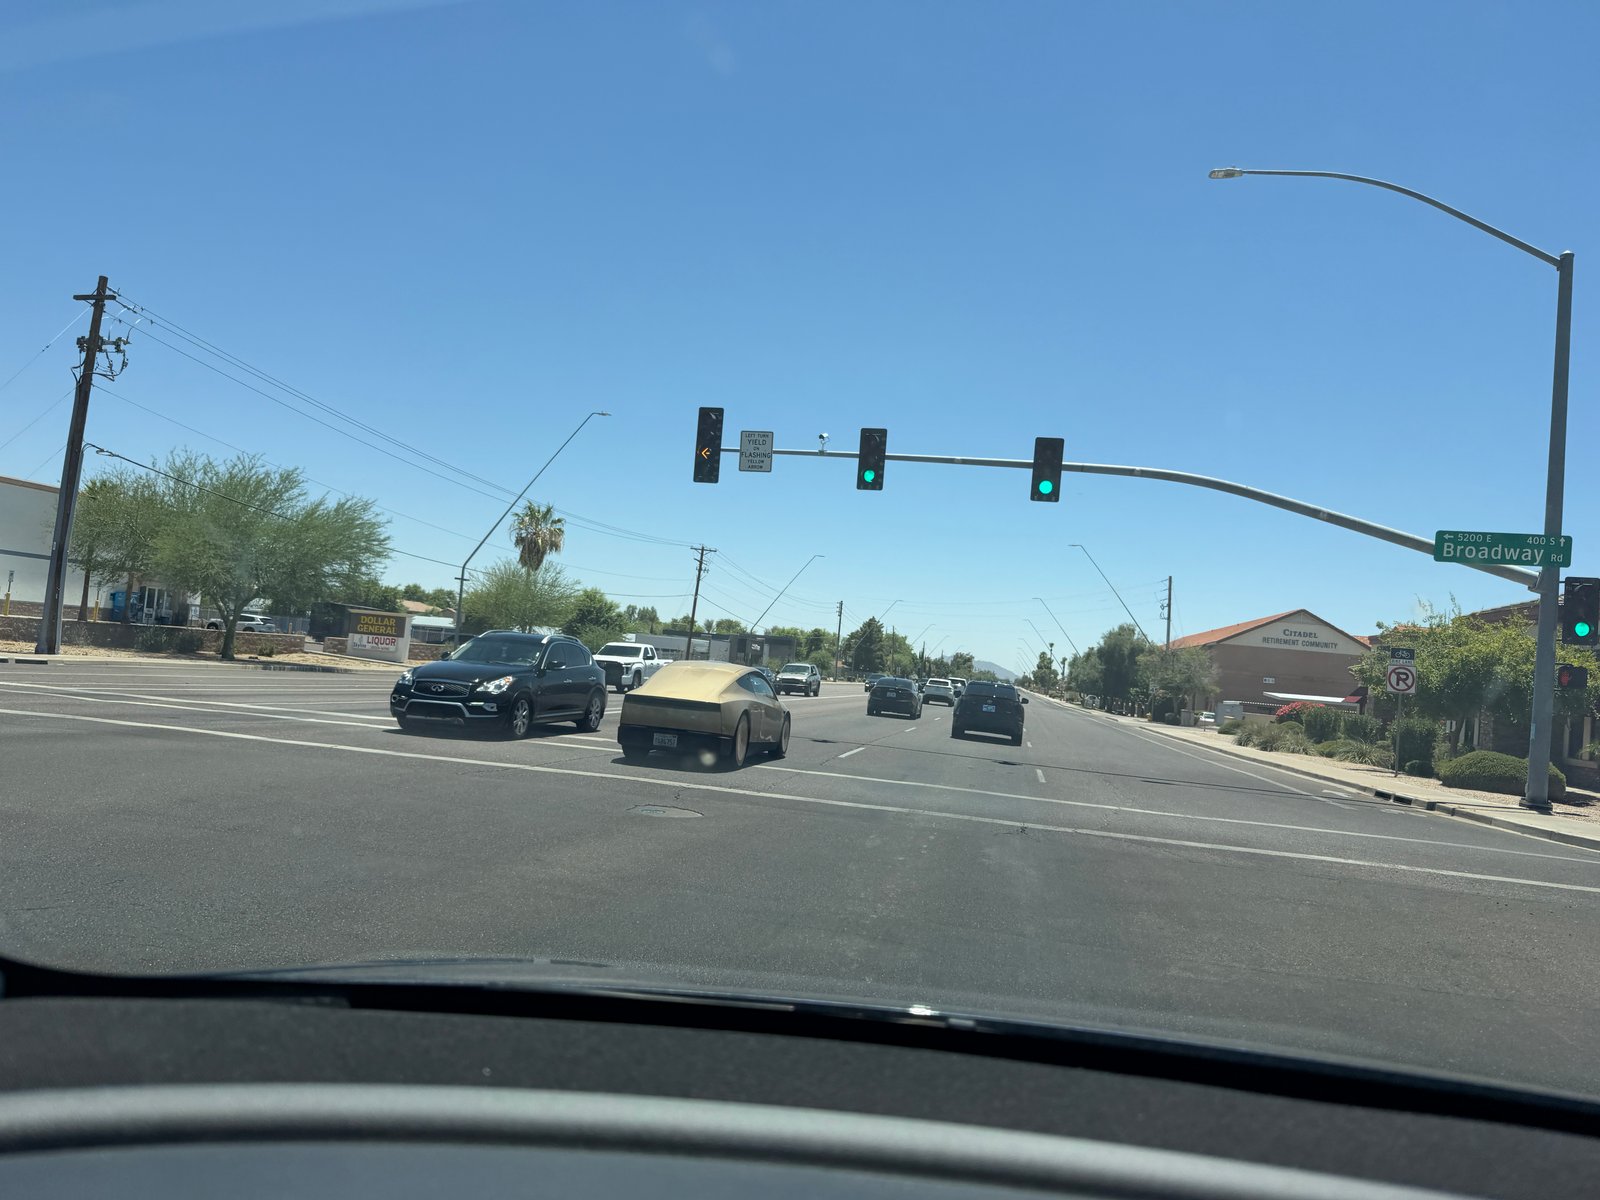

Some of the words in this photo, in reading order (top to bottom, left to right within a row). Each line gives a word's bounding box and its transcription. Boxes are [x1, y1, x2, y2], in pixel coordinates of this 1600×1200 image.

[741, 451, 771, 459] FLASHING
[1457, 533, 1483, 542] 5200
[1486, 534, 1492, 543] E
[1526, 536, 1546, 545] 400
[1549, 537, 1556, 545] S
[1442, 542, 1544, 565] Broadway
[1550, 553, 1563, 562] Rd
[360, 615, 396, 626] DOLLAR
[357, 624, 398, 635] GENERAL
[1283, 628, 1318, 639] CITADEL
[367, 635, 397, 646] LIQUOR
[1262, 637, 1300, 646] RETIREMENT
[1301, 640, 1338, 649] COMMUNITY
